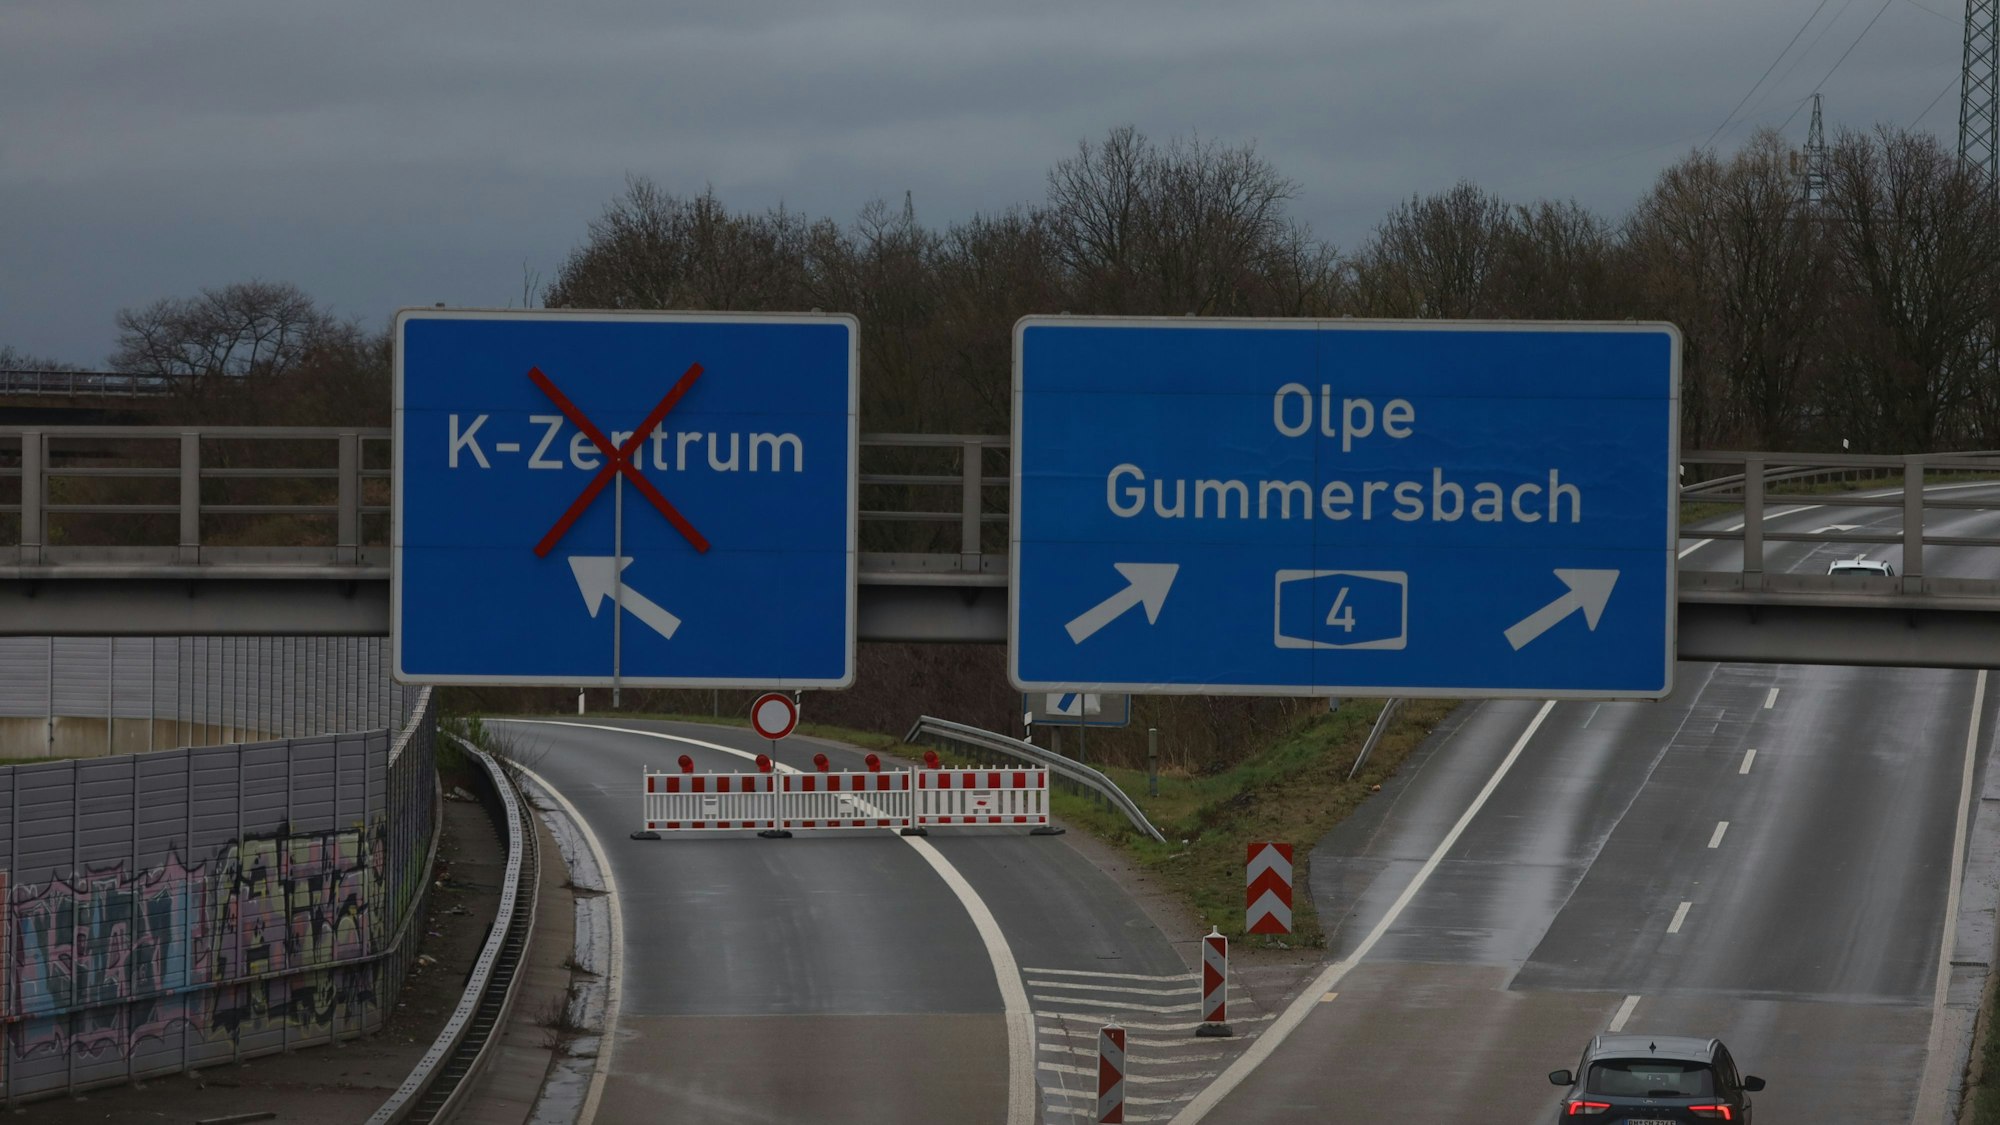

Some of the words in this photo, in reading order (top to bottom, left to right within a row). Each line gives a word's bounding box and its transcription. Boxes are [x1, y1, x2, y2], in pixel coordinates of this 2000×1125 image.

[1273, 382, 1416, 452] Olpe
[1106, 463, 1582, 523] Gummersbach
[1326, 587, 1355, 632] 4
